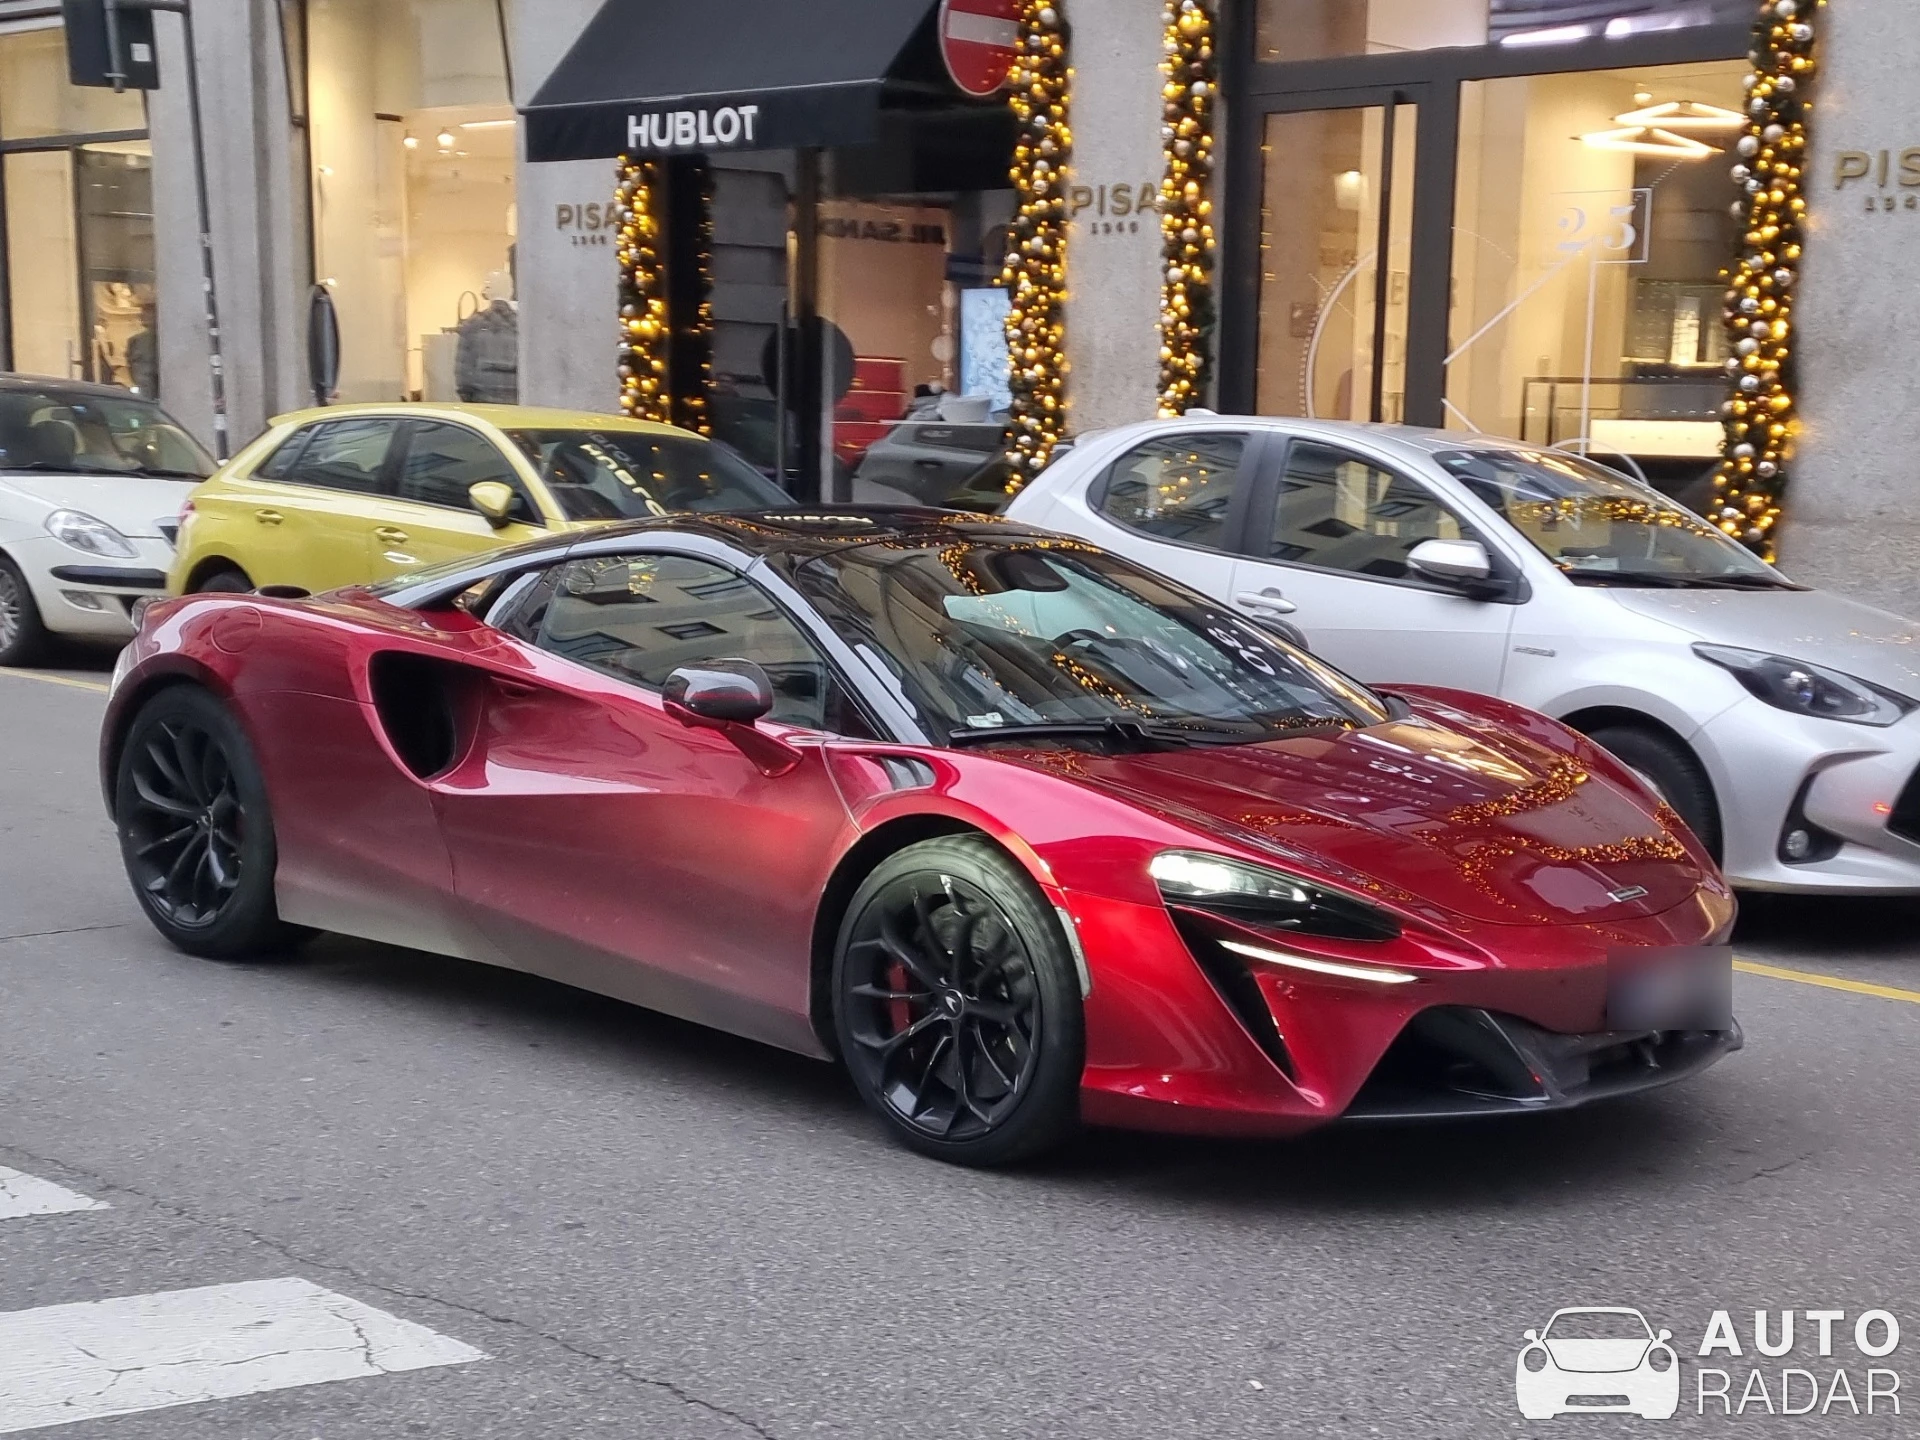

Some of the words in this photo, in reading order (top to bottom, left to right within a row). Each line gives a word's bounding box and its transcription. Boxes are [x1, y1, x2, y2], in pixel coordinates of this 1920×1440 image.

[627, 105, 758, 148] HUBLOT
[1834, 148, 1920, 190] PIS
[556, 202, 618, 231] PISA
[1070, 182, 1161, 217] PISA
